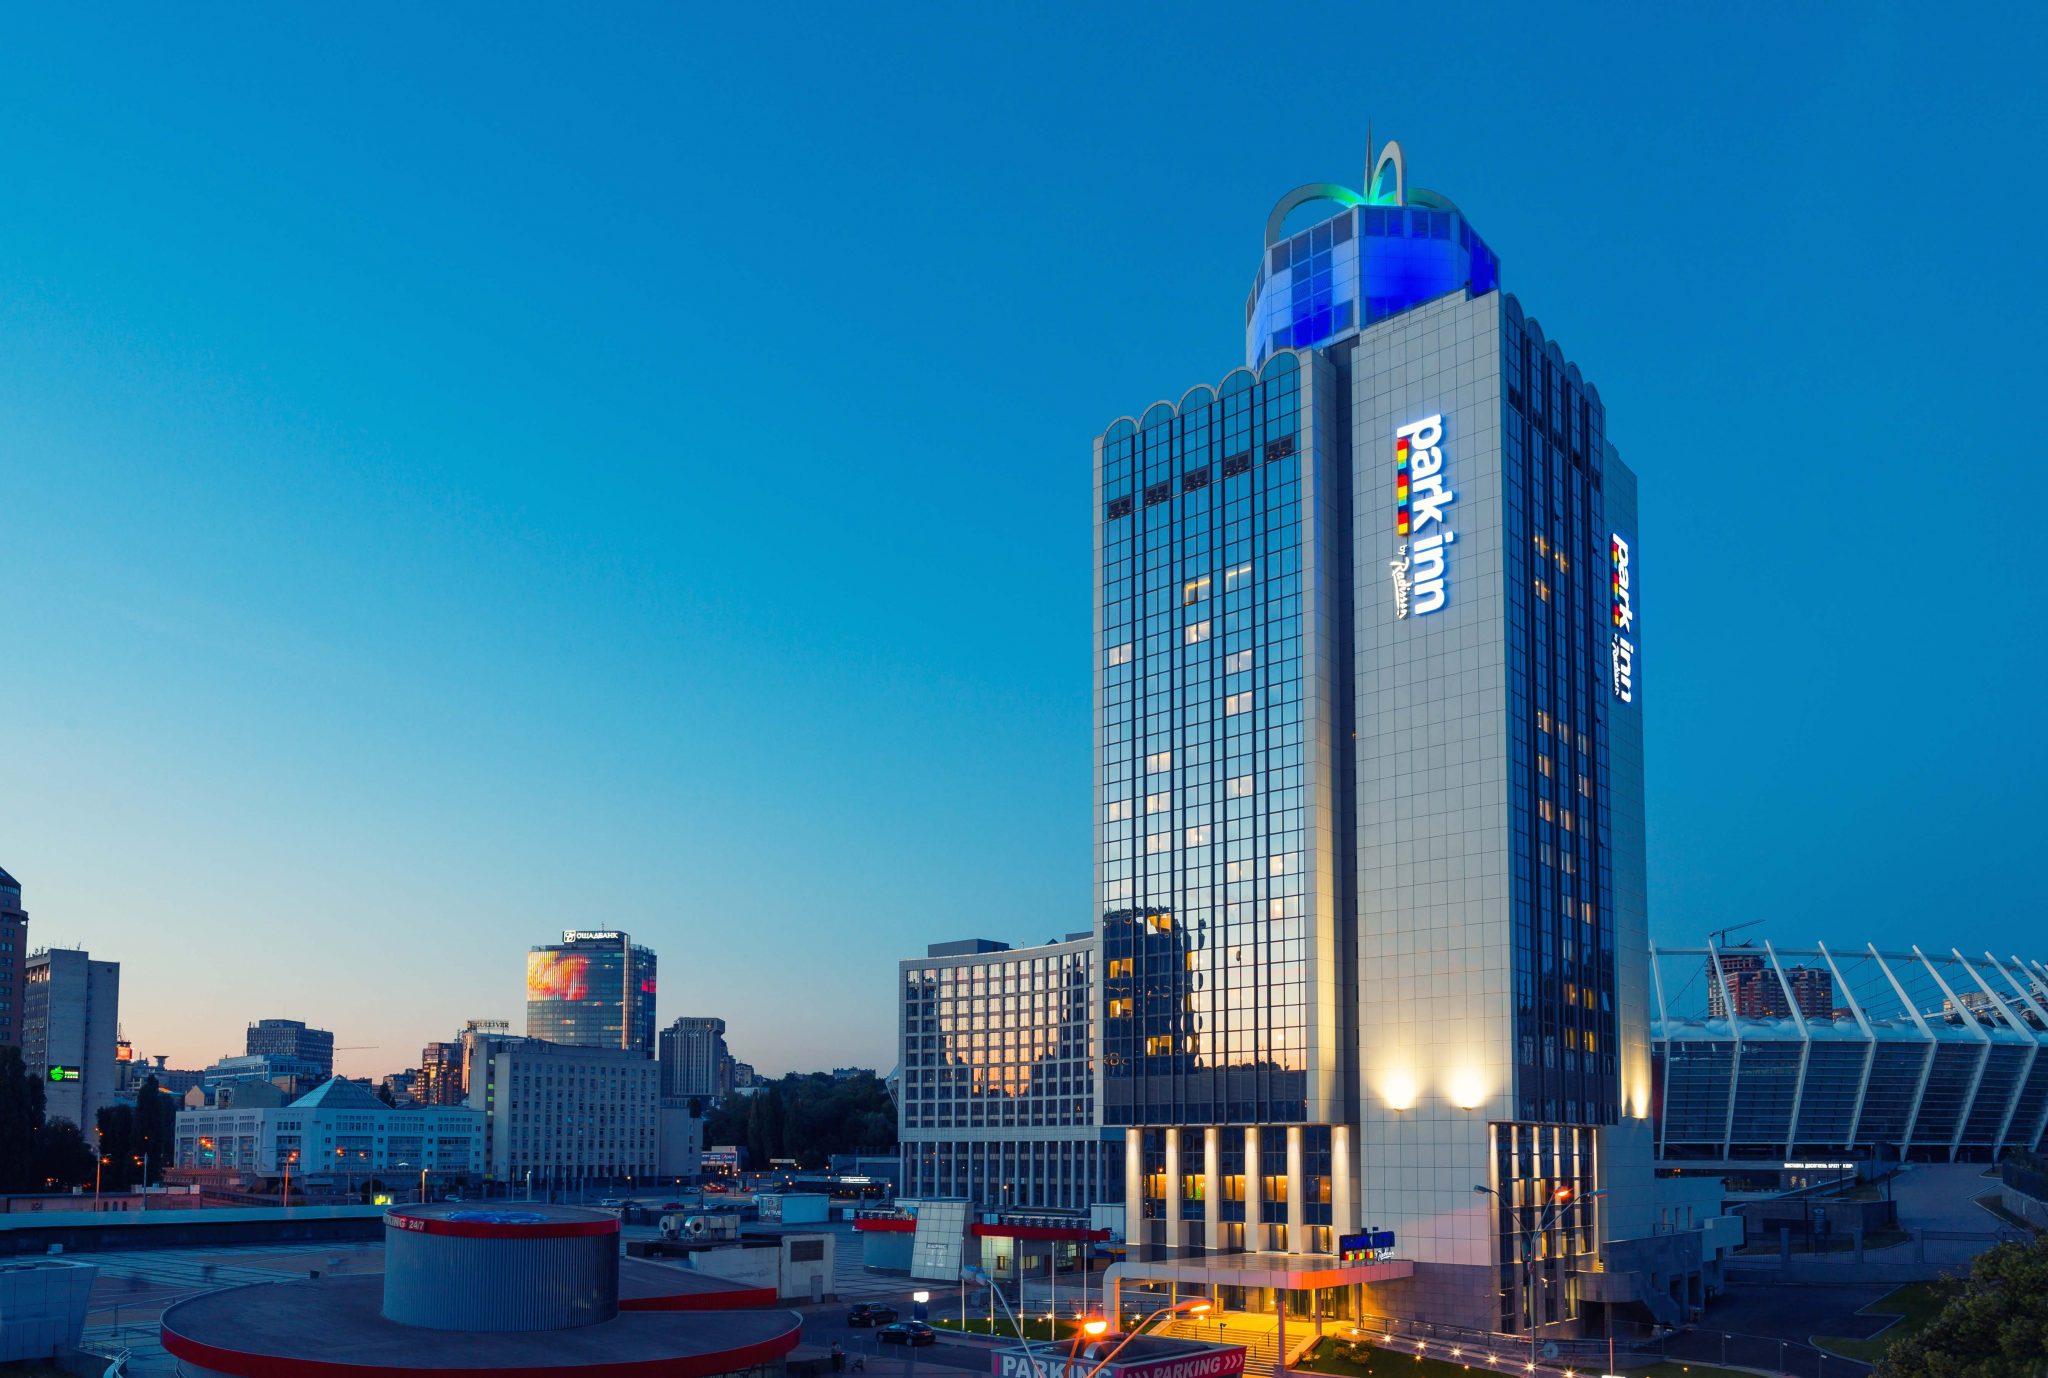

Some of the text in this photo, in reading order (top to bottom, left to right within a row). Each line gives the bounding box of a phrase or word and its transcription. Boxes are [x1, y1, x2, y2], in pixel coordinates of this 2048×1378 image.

[1396, 414, 1454, 615] park inn
[1389, 544, 1413, 620] by Radisson
[1612, 533, 1634, 703] park inn
[408, 1219, 425, 1231] 24/7
[1153, 1355, 1221, 1378] PARKING
